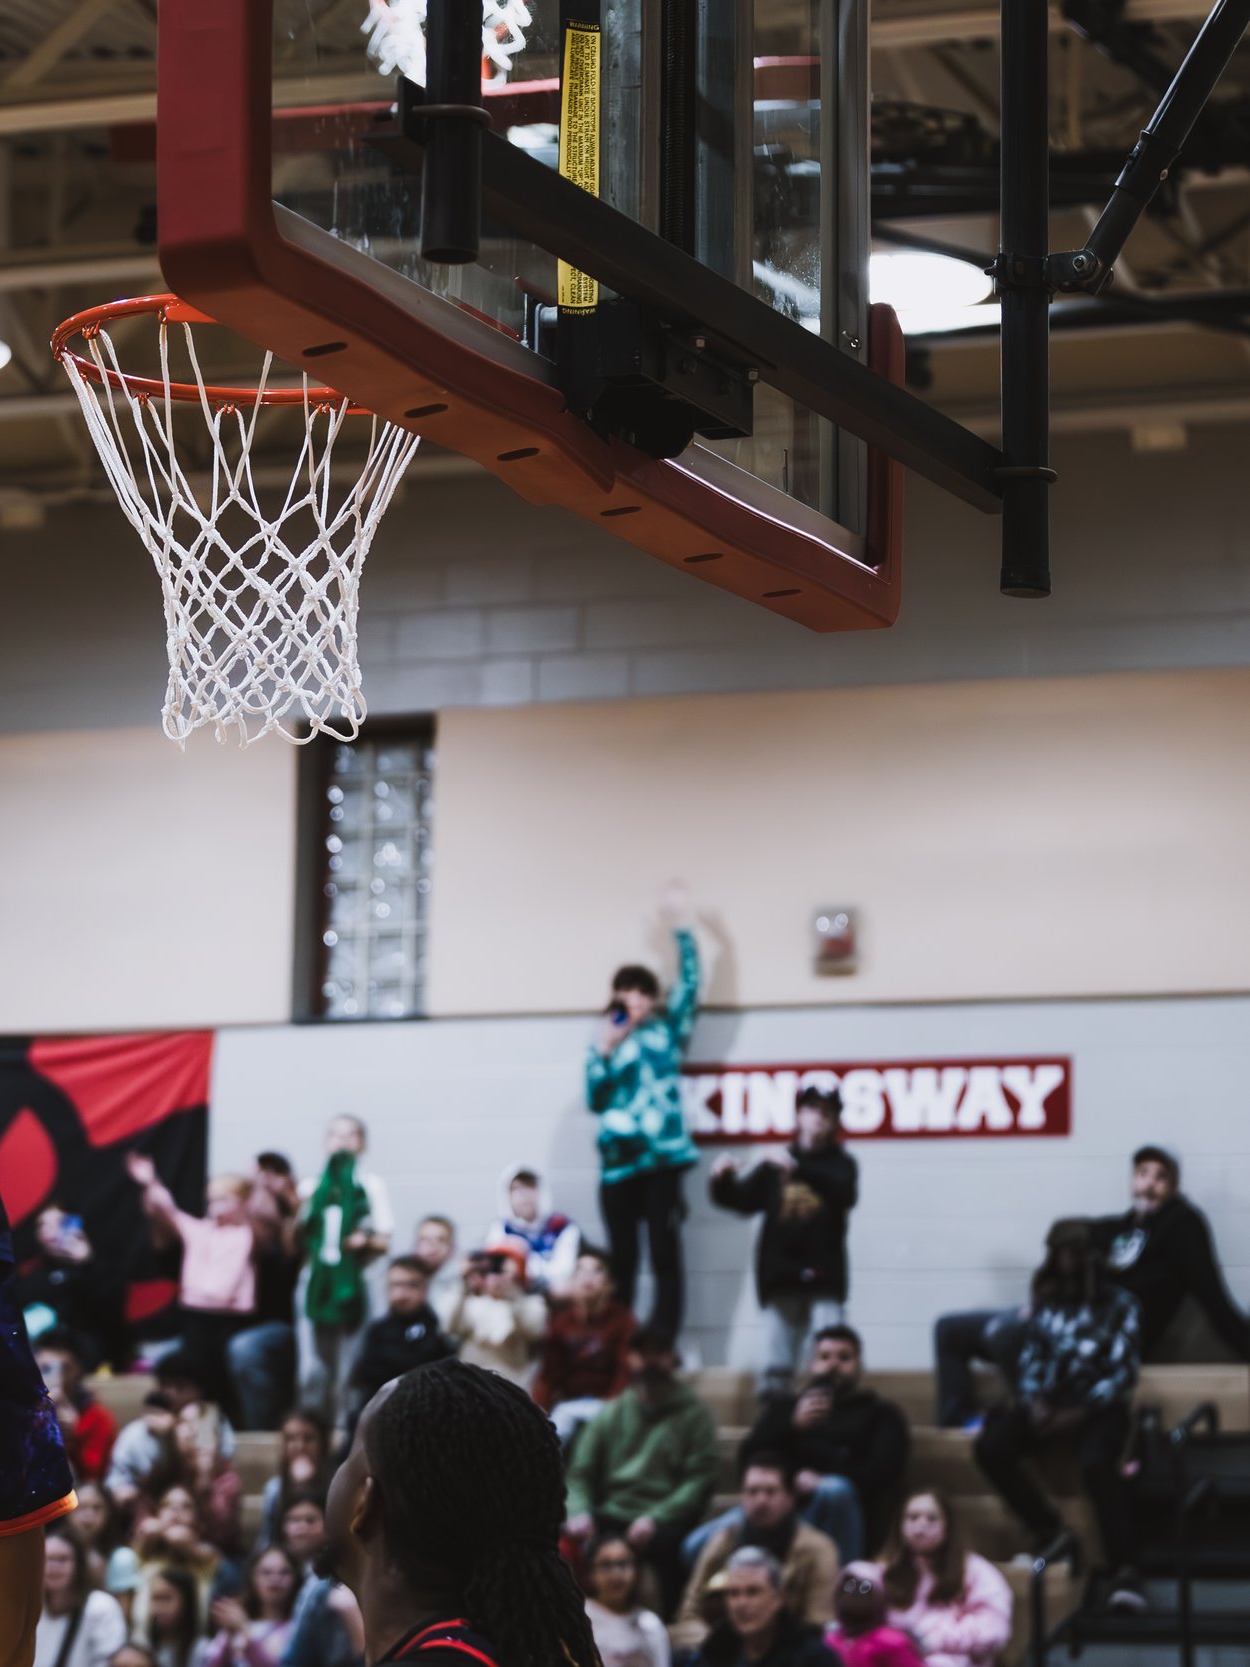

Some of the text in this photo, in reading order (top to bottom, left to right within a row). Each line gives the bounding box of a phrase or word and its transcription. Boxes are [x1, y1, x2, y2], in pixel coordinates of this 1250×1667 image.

[570, 21, 600, 30] WARNING
[579, 35, 584, 43] DO
[591, 36, 596, 44] ON
[584, 145, 589, 154] ON
